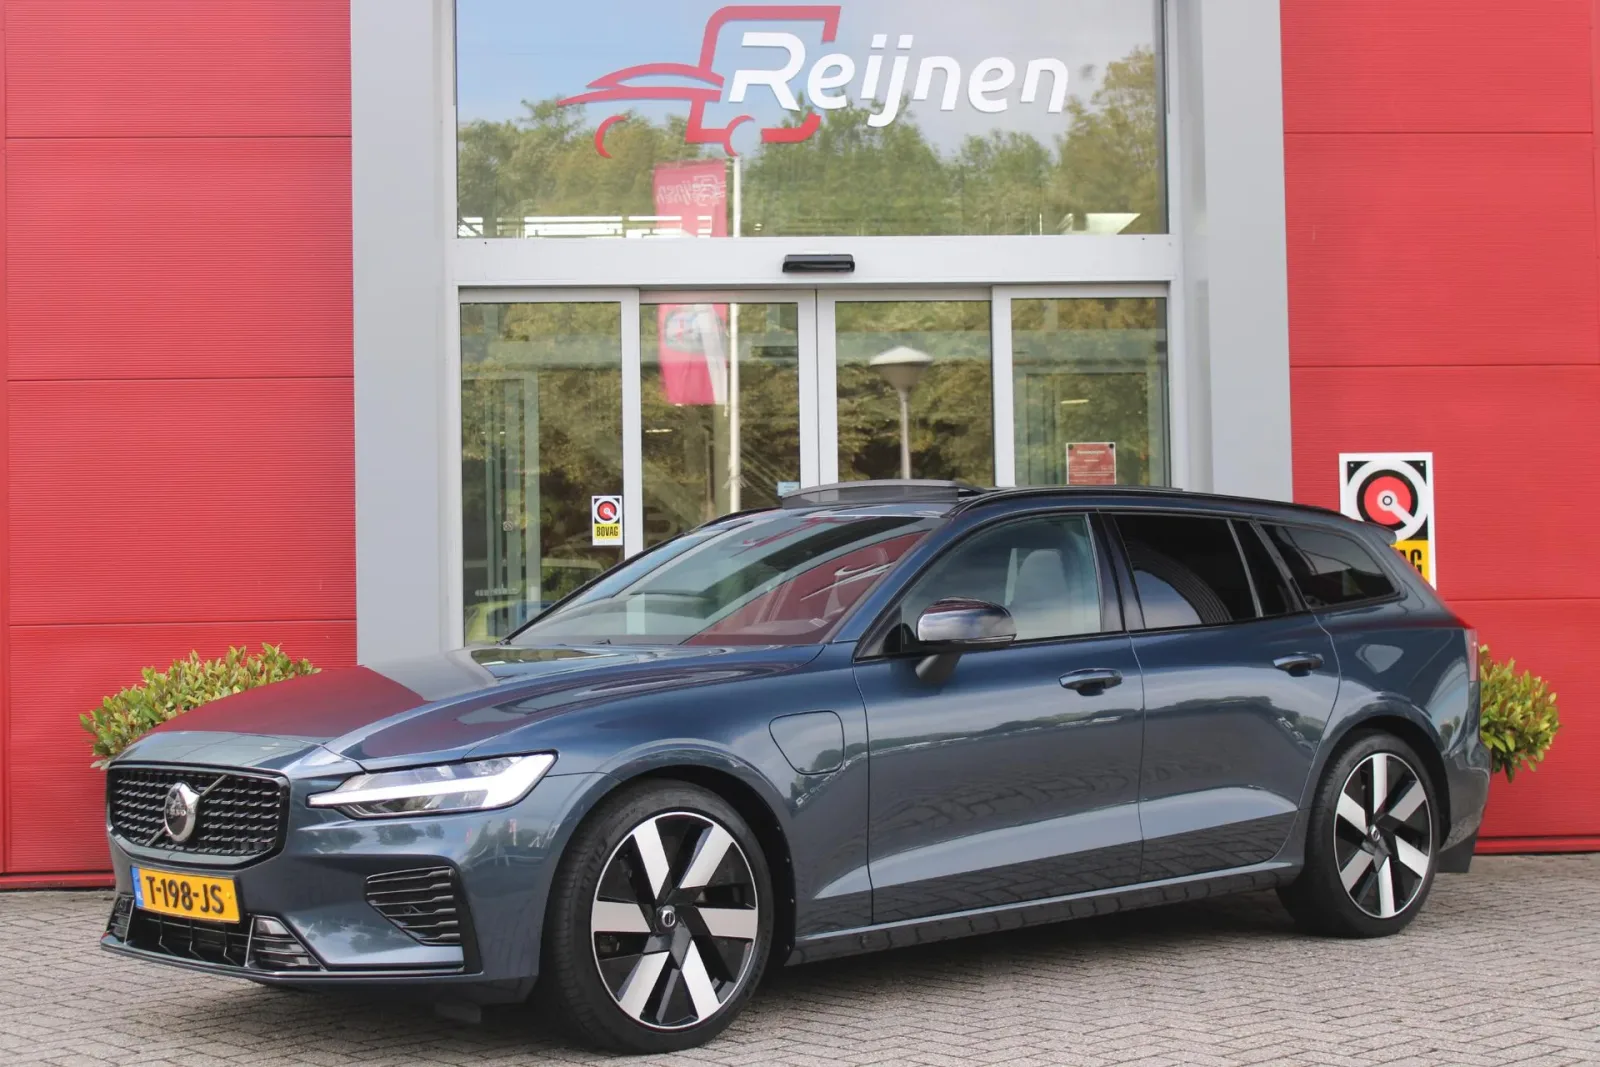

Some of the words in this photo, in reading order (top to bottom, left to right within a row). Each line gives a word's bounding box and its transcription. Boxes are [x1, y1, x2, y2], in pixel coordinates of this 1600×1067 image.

[729, 32, 1069, 128] Reijnen
[596, 526, 619, 537] BOVAG
[145, 876, 225, 914] T-198-JS
